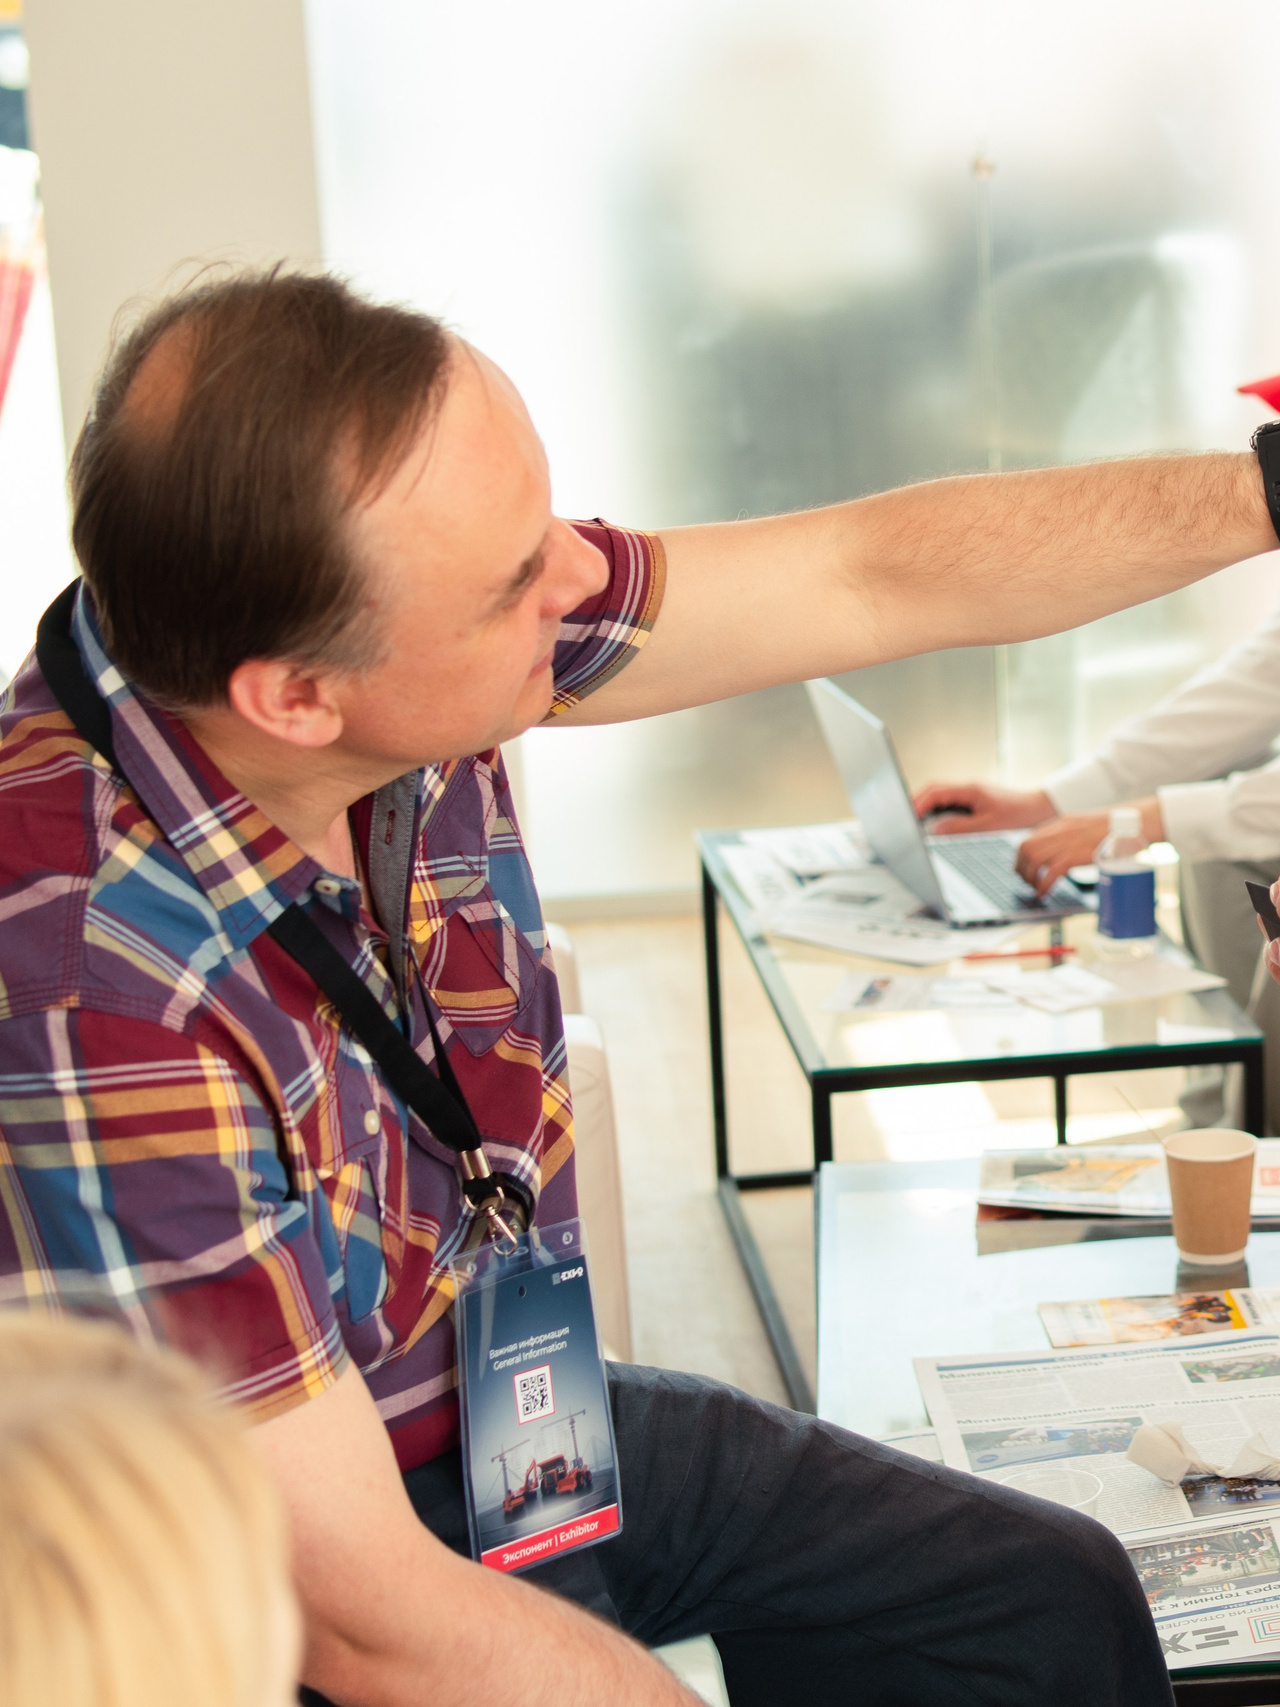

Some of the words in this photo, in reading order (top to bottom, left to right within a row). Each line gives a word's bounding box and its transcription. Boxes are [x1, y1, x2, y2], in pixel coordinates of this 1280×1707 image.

[489, 1342, 518, 1360] Важная
[518, 1326, 570, 1350] информация
[493, 1353, 522, 1371] General
[522, 1340, 568, 1361] Information
[939, 1366, 1038, 1380] Маленький
[957, 1405, 1106, 1425] Мотивированные
[502, 1538, 554, 1564] Экспонент
[559, 1520, 600, 1543] Exhibitor
[1183, 1591, 1243, 1607] тернии
